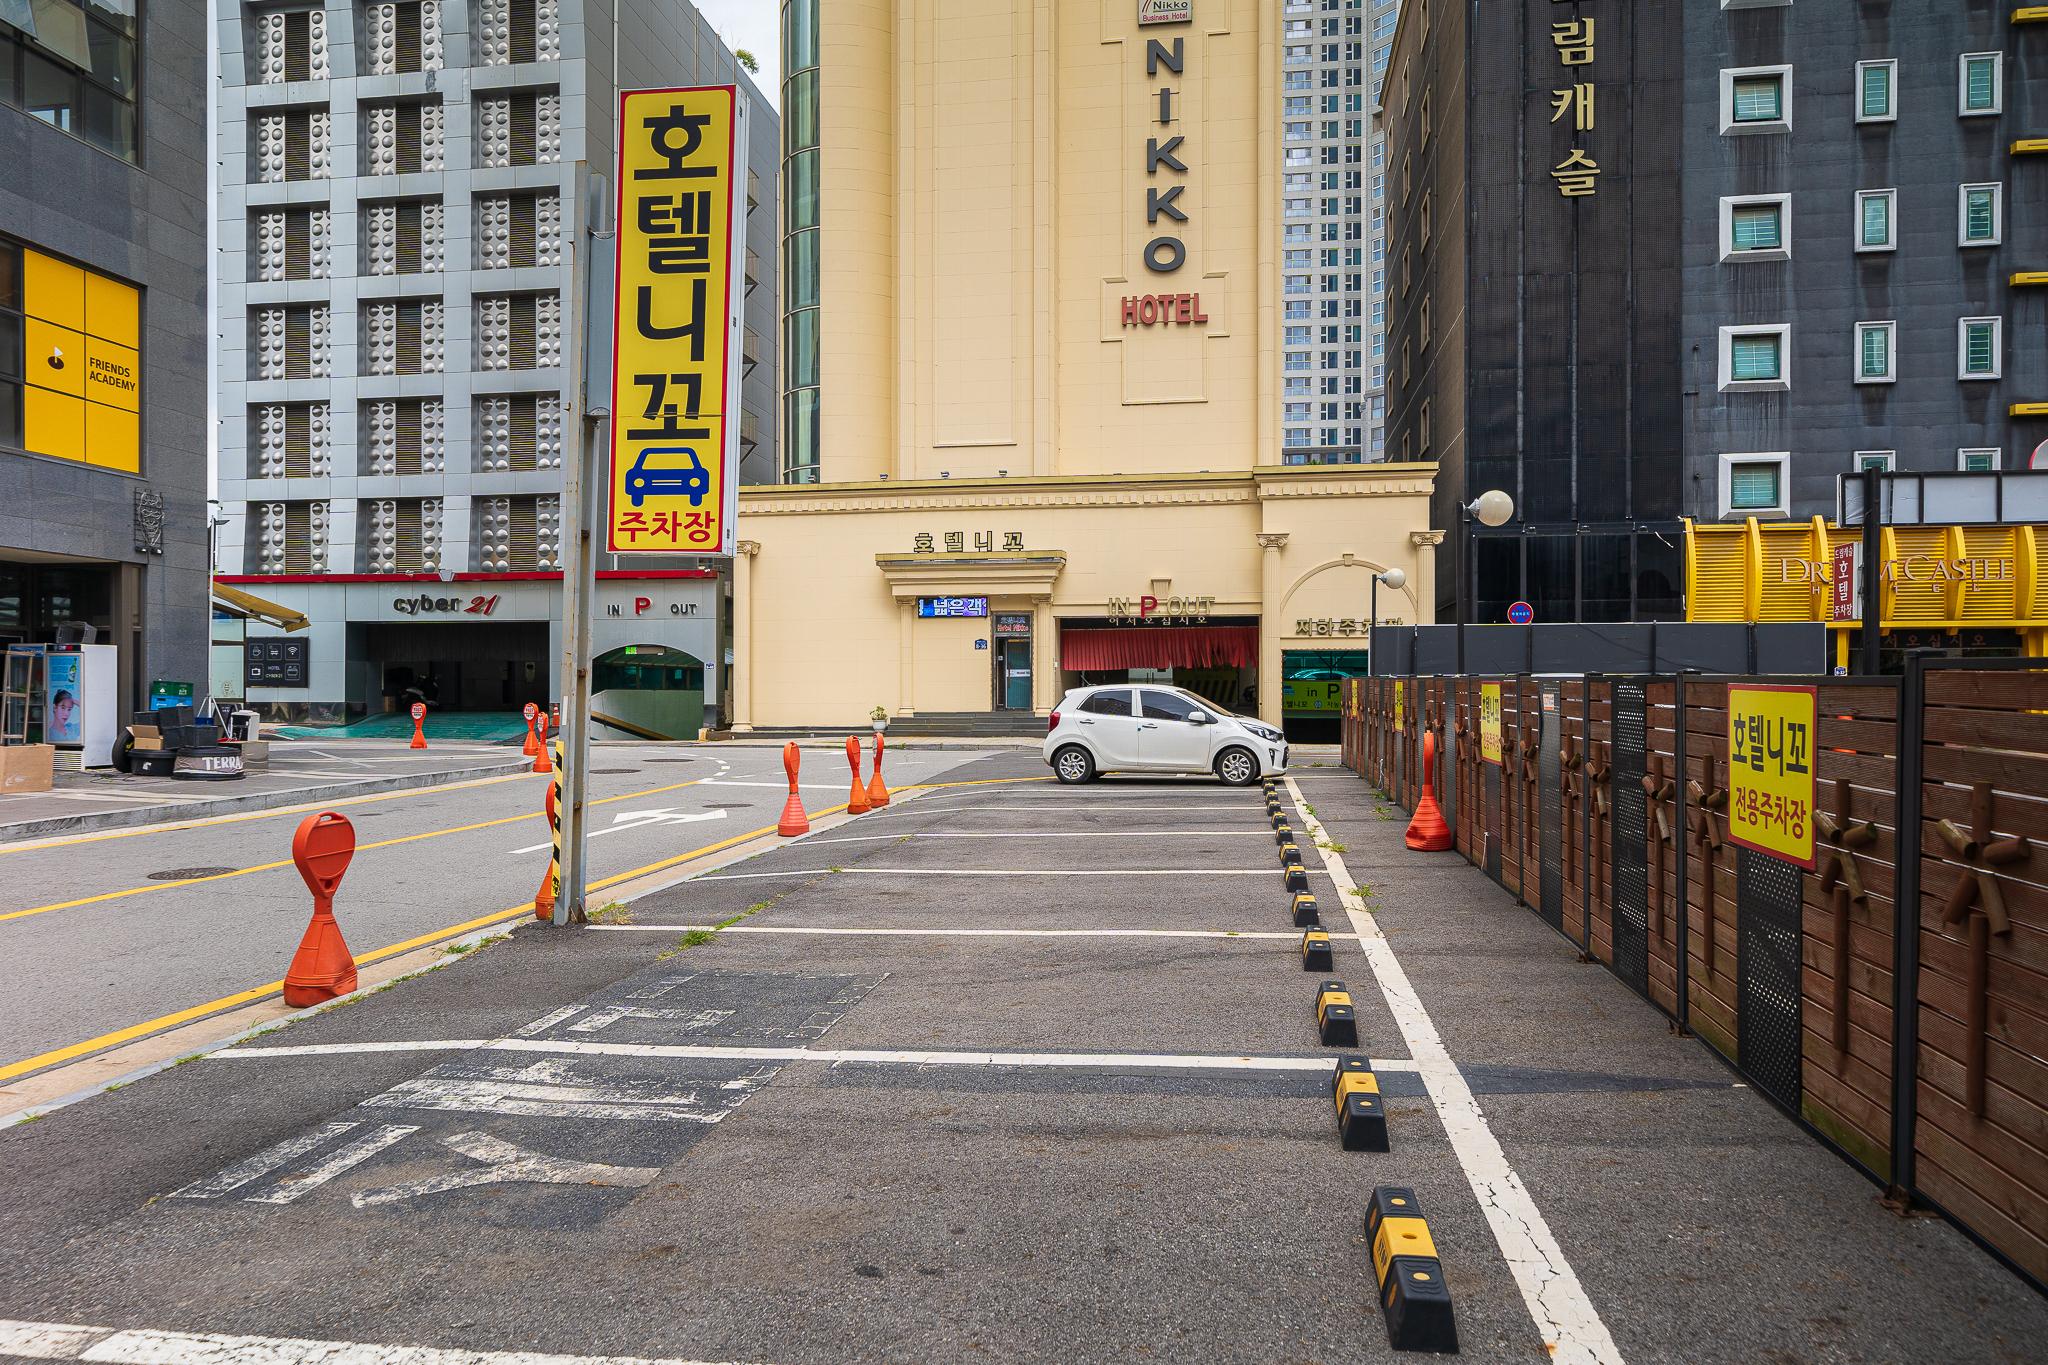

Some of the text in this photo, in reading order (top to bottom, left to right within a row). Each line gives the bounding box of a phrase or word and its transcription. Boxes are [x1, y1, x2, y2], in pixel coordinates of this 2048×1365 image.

[1142, 12, 1188, 22] Business Hotel
[1153, 1, 1188, 10] Nikko
[1551, 0, 1601, 197] 림캐슬
[1144, 37, 1189, 273] NIKKO
[626, 105, 718, 441] 호텔니꼬
[1121, 293, 1208, 326] HOTEL
[90, 357, 131, 378] FRIENDS
[89, 371, 136, 391] ACADEMY
[617, 510, 716, 543] 주차장
[914, 531, 1023, 552] 호텔니꼬
[1904, 554, 2016, 581] CASTLE
[1838, 560, 1849, 602] 호텔
[393, 594, 499, 616] cyber 21
[608, 597, 698, 616] IN P OUT
[1108, 595, 1215, 619] IN P OUT
[1834, 604, 1853, 617] 주차장
[1327, 683, 1340, 700] P
[1732, 712, 1808, 777] 호텔니꼬
[1735, 786, 1807, 840] 전용주차장
